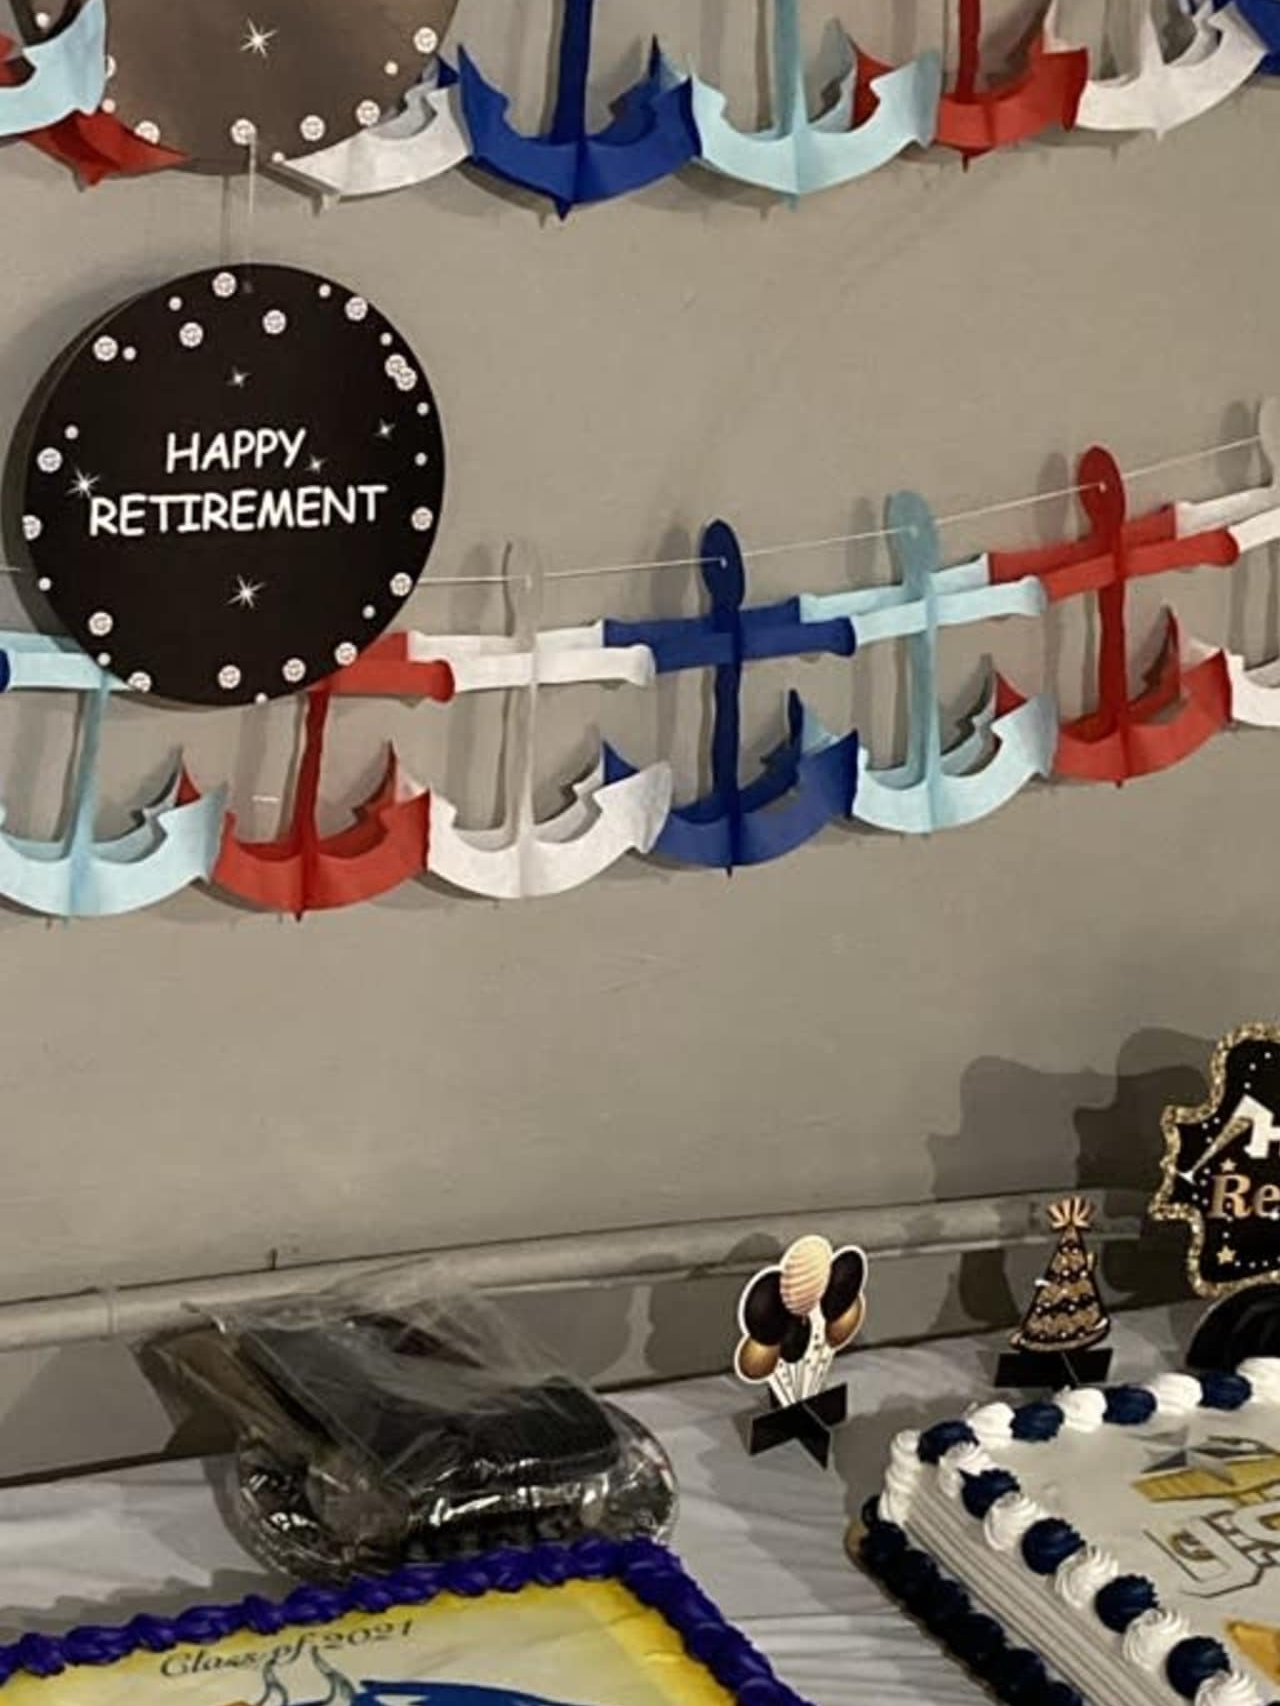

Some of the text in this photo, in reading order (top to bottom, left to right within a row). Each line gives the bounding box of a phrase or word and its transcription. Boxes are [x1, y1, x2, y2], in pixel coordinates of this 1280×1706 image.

[164, 428, 307, 474] HAPPY
[88, 485, 389, 537] RETIREMENT
[160, 1618, 413, 1678] Class of 2021
